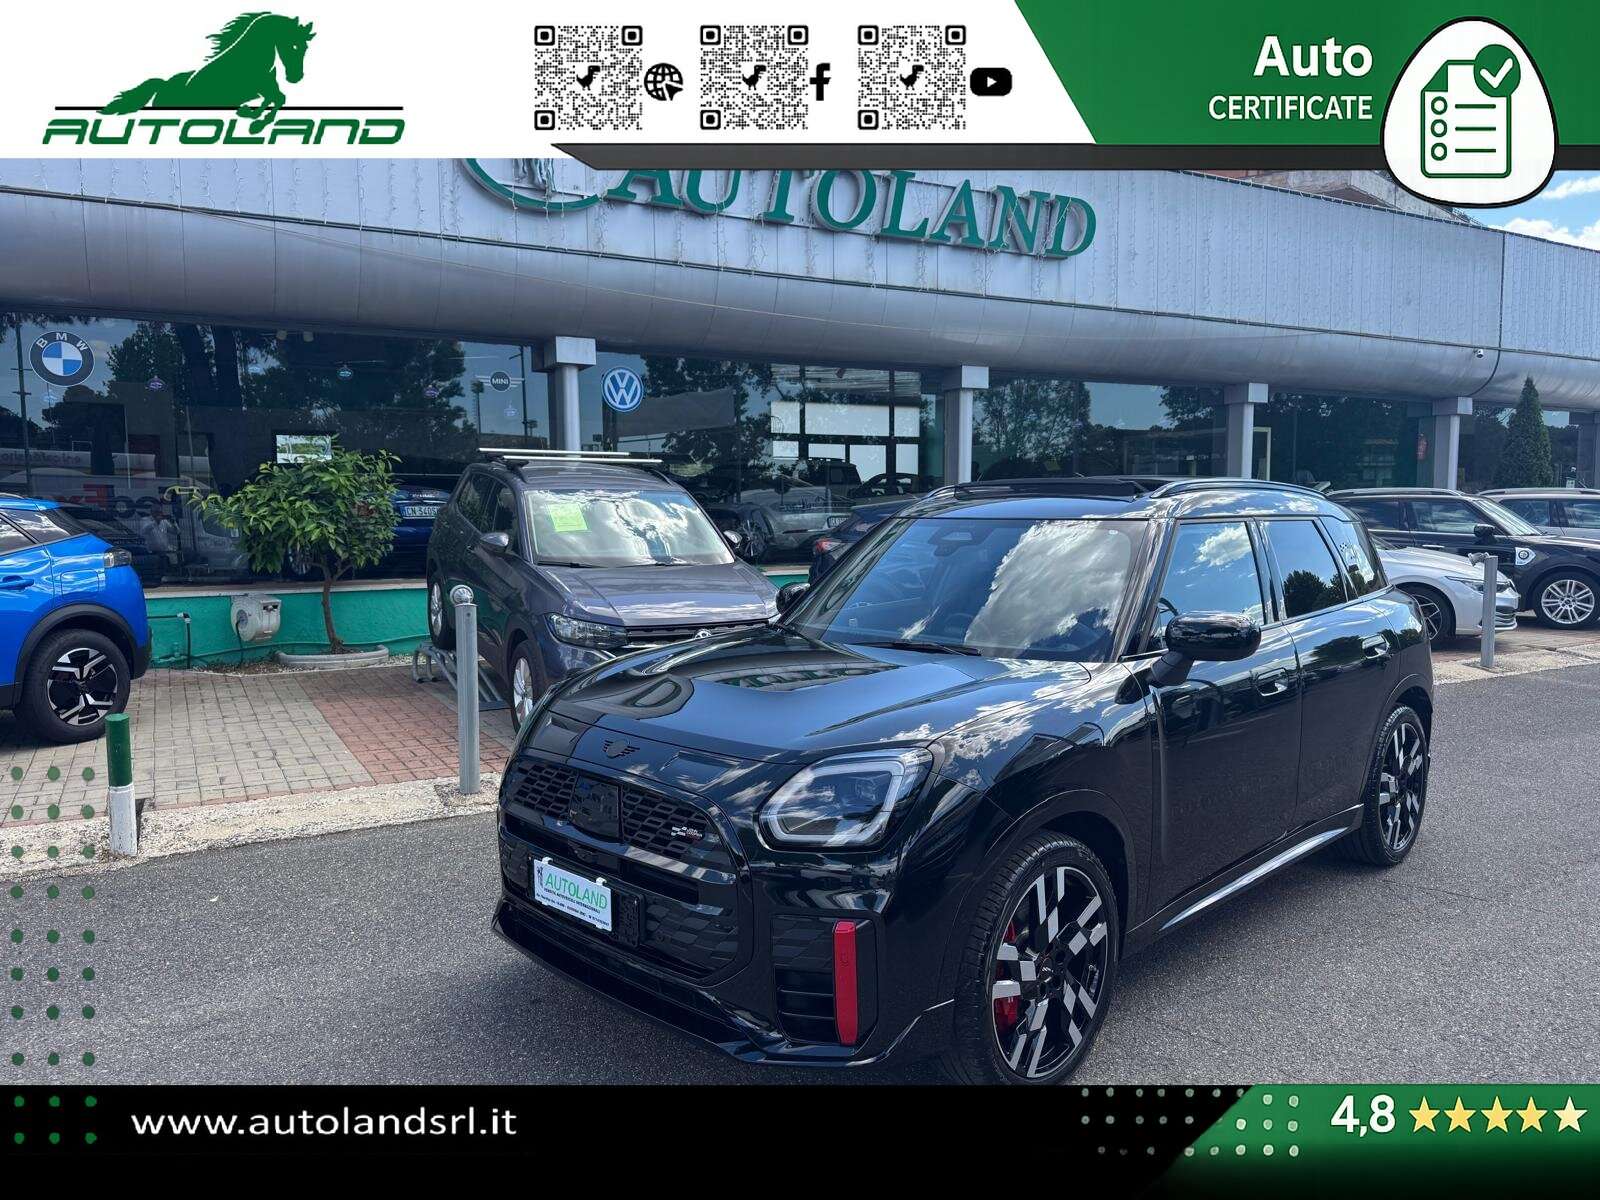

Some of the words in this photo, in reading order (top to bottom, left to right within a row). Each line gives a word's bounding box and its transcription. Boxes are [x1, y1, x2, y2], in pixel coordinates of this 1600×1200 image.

[36, 331, 88, 351] BMW
[491, 377, 509, 385] MINI
[545, 873, 608, 909] AUTOLAND
